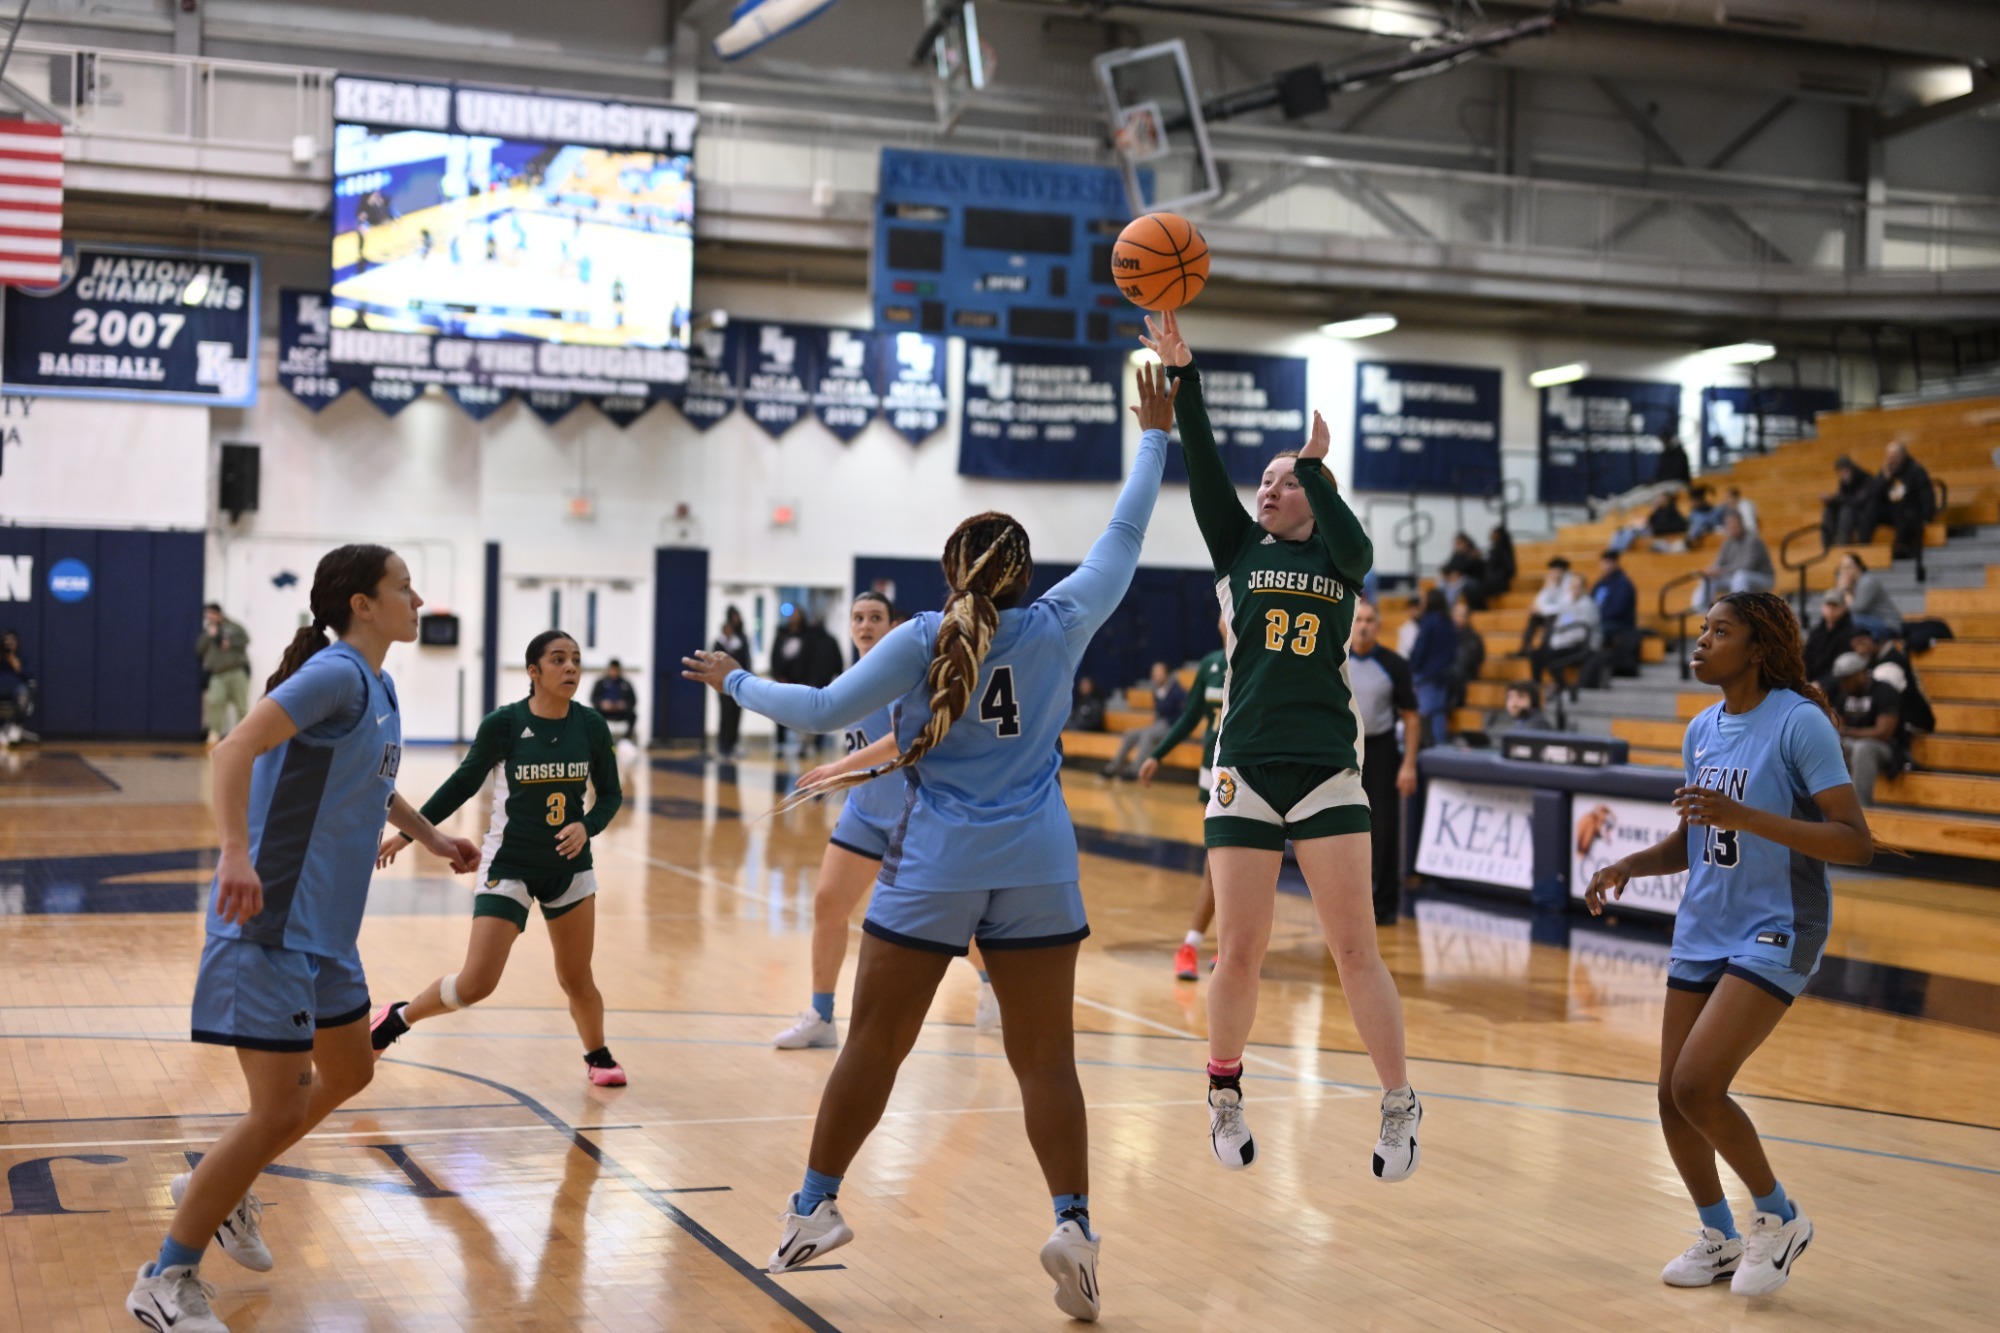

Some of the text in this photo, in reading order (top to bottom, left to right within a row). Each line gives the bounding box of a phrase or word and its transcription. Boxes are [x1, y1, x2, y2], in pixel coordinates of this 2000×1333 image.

[334, 77, 697, 150] KEAN UNIVERSITY
[68, 308, 186, 348] 2007
[38, 352, 165, 382] BASEBALL
[331, 330, 431, 365] HOME
[435, 339, 475, 368] OF
[476, 342, 534, 373] THE
[538, 344, 690, 384] COUGARS
[1248, 570, 1344, 600] JERSEY CITY
[1265, 608, 1320, 656] 23
[979, 665, 1021, 738] 4
[515, 761, 589, 780] JERSEY CITY
[1694, 766, 1749, 802] KEAN
[546, 792, 566, 826] 3
[1618, 826, 1650, 845] HOME
[1703, 824, 1740, 869] 13
